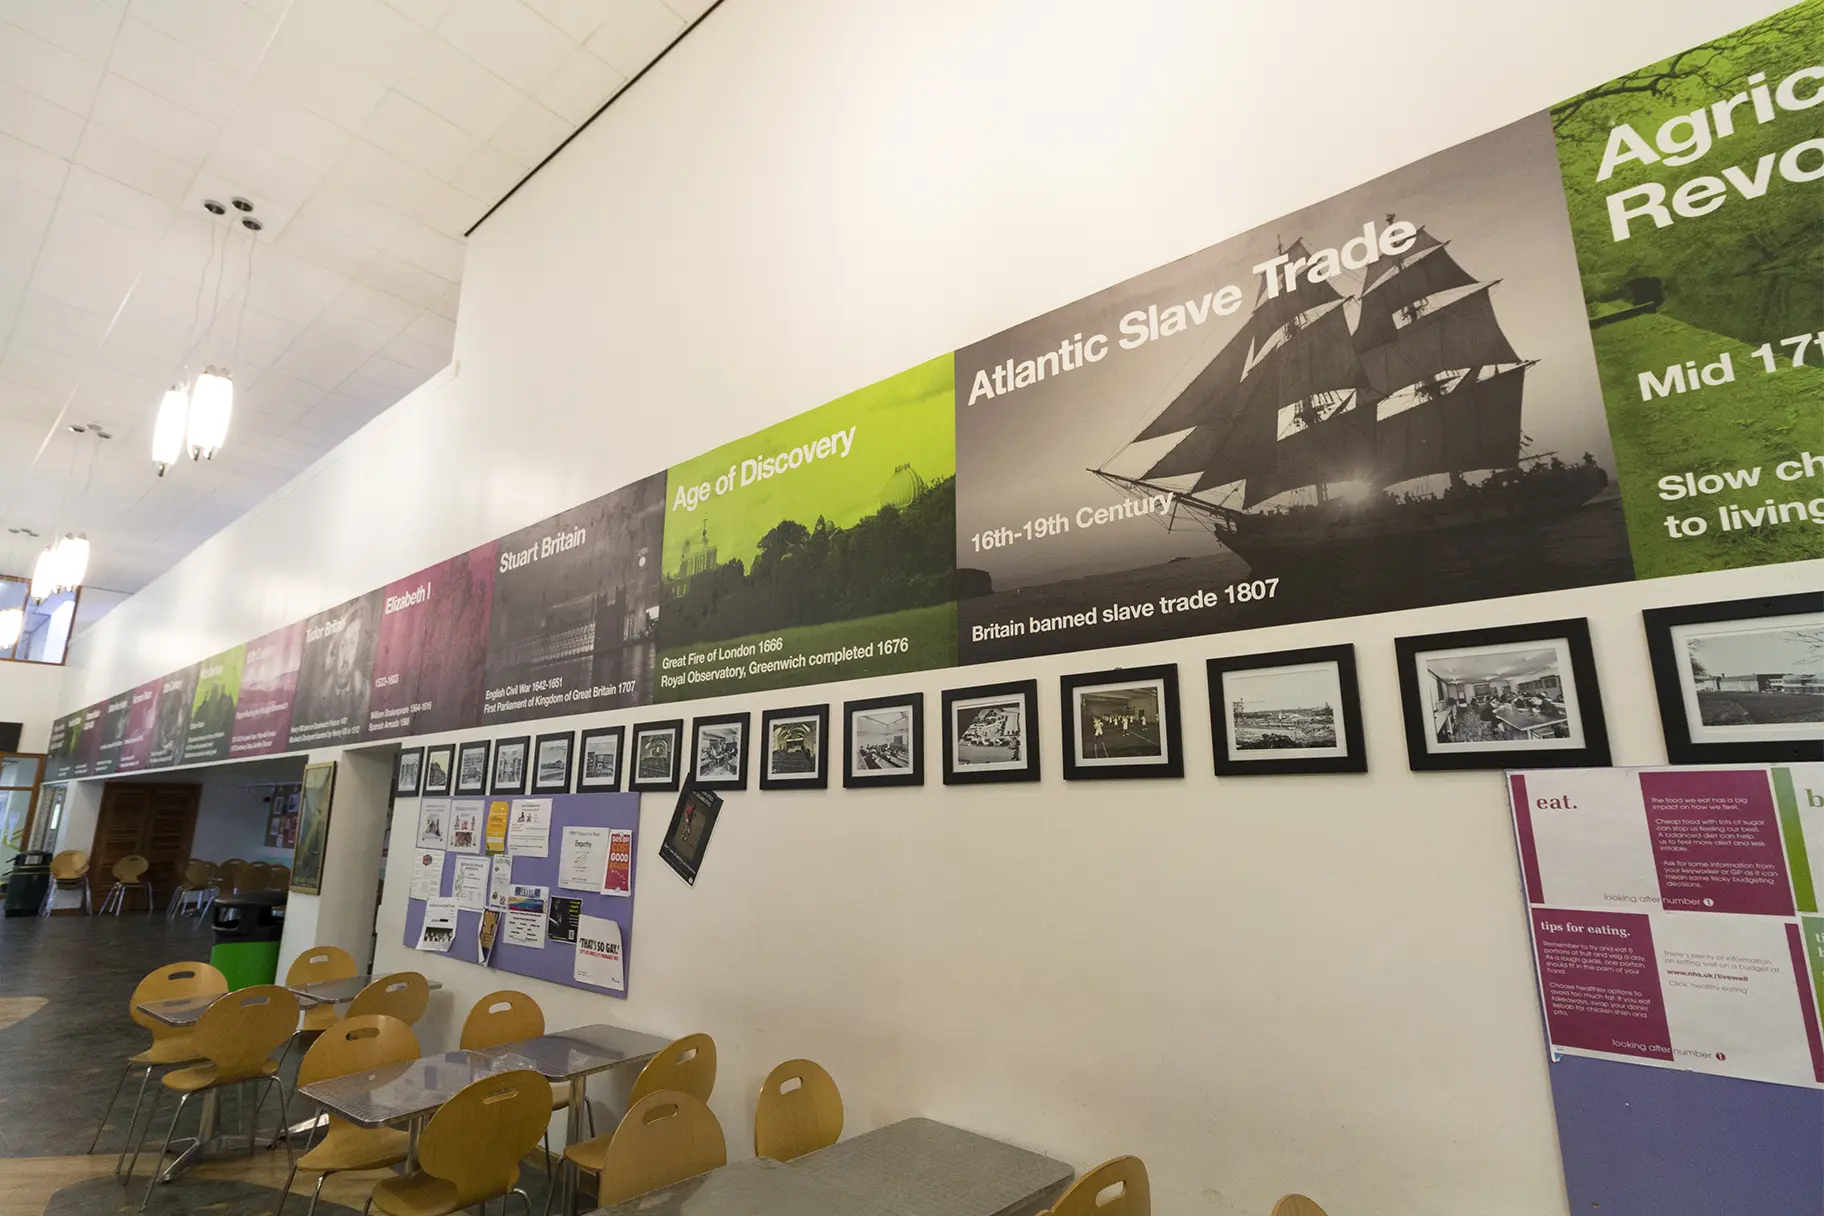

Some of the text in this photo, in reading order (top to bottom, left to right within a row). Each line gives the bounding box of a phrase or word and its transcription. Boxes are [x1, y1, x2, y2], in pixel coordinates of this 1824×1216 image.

[1596, 66, 1824, 182] Agric
[1606, 138, 1824, 242] Revo
[968, 220, 1418, 405] Atlantic Slave Trade
[1638, 352, 1735, 401] Mid
[672, 426, 856, 512] Age of Discovery
[1658, 467, 1761, 500] Slow
[971, 492, 1174, 552] 16th-19th Century
[1664, 516, 1707, 538] to
[499, 526, 586, 573] Stuart Britain
[385, 582, 431, 614] Elizabeth I
[972, 578, 1280, 642] Britain banned slave trade 1807
[661, 637, 909, 688] Royal Observatory, Greenwich completed 1676
[662, 637, 783, 670] Great Fire of London 1666
[484, 681, 636, 714] First Parliament of Kingdom of Great Britain 1707
[485, 688, 505, 701] English
[506, 684, 518, 696] Civil
[519, 683, 531, 694] War
[1537, 795, 1577, 810] eat.
[611, 852, 628, 862] GOOD
[1604, 893, 1637, 904] looking
[1639, 894, 1660, 904] after
[1663, 897, 1700, 905] number
[1541, 921, 1630, 938] tips for eating.
[597, 942, 604, 952] SO
[1666, 969, 1748, 982] www.nhs.uk/livewell
[1612, 1039, 1646, 1051] looking
[1649, 1041, 1671, 1054] after
[1673, 1047, 1712, 1059] number
